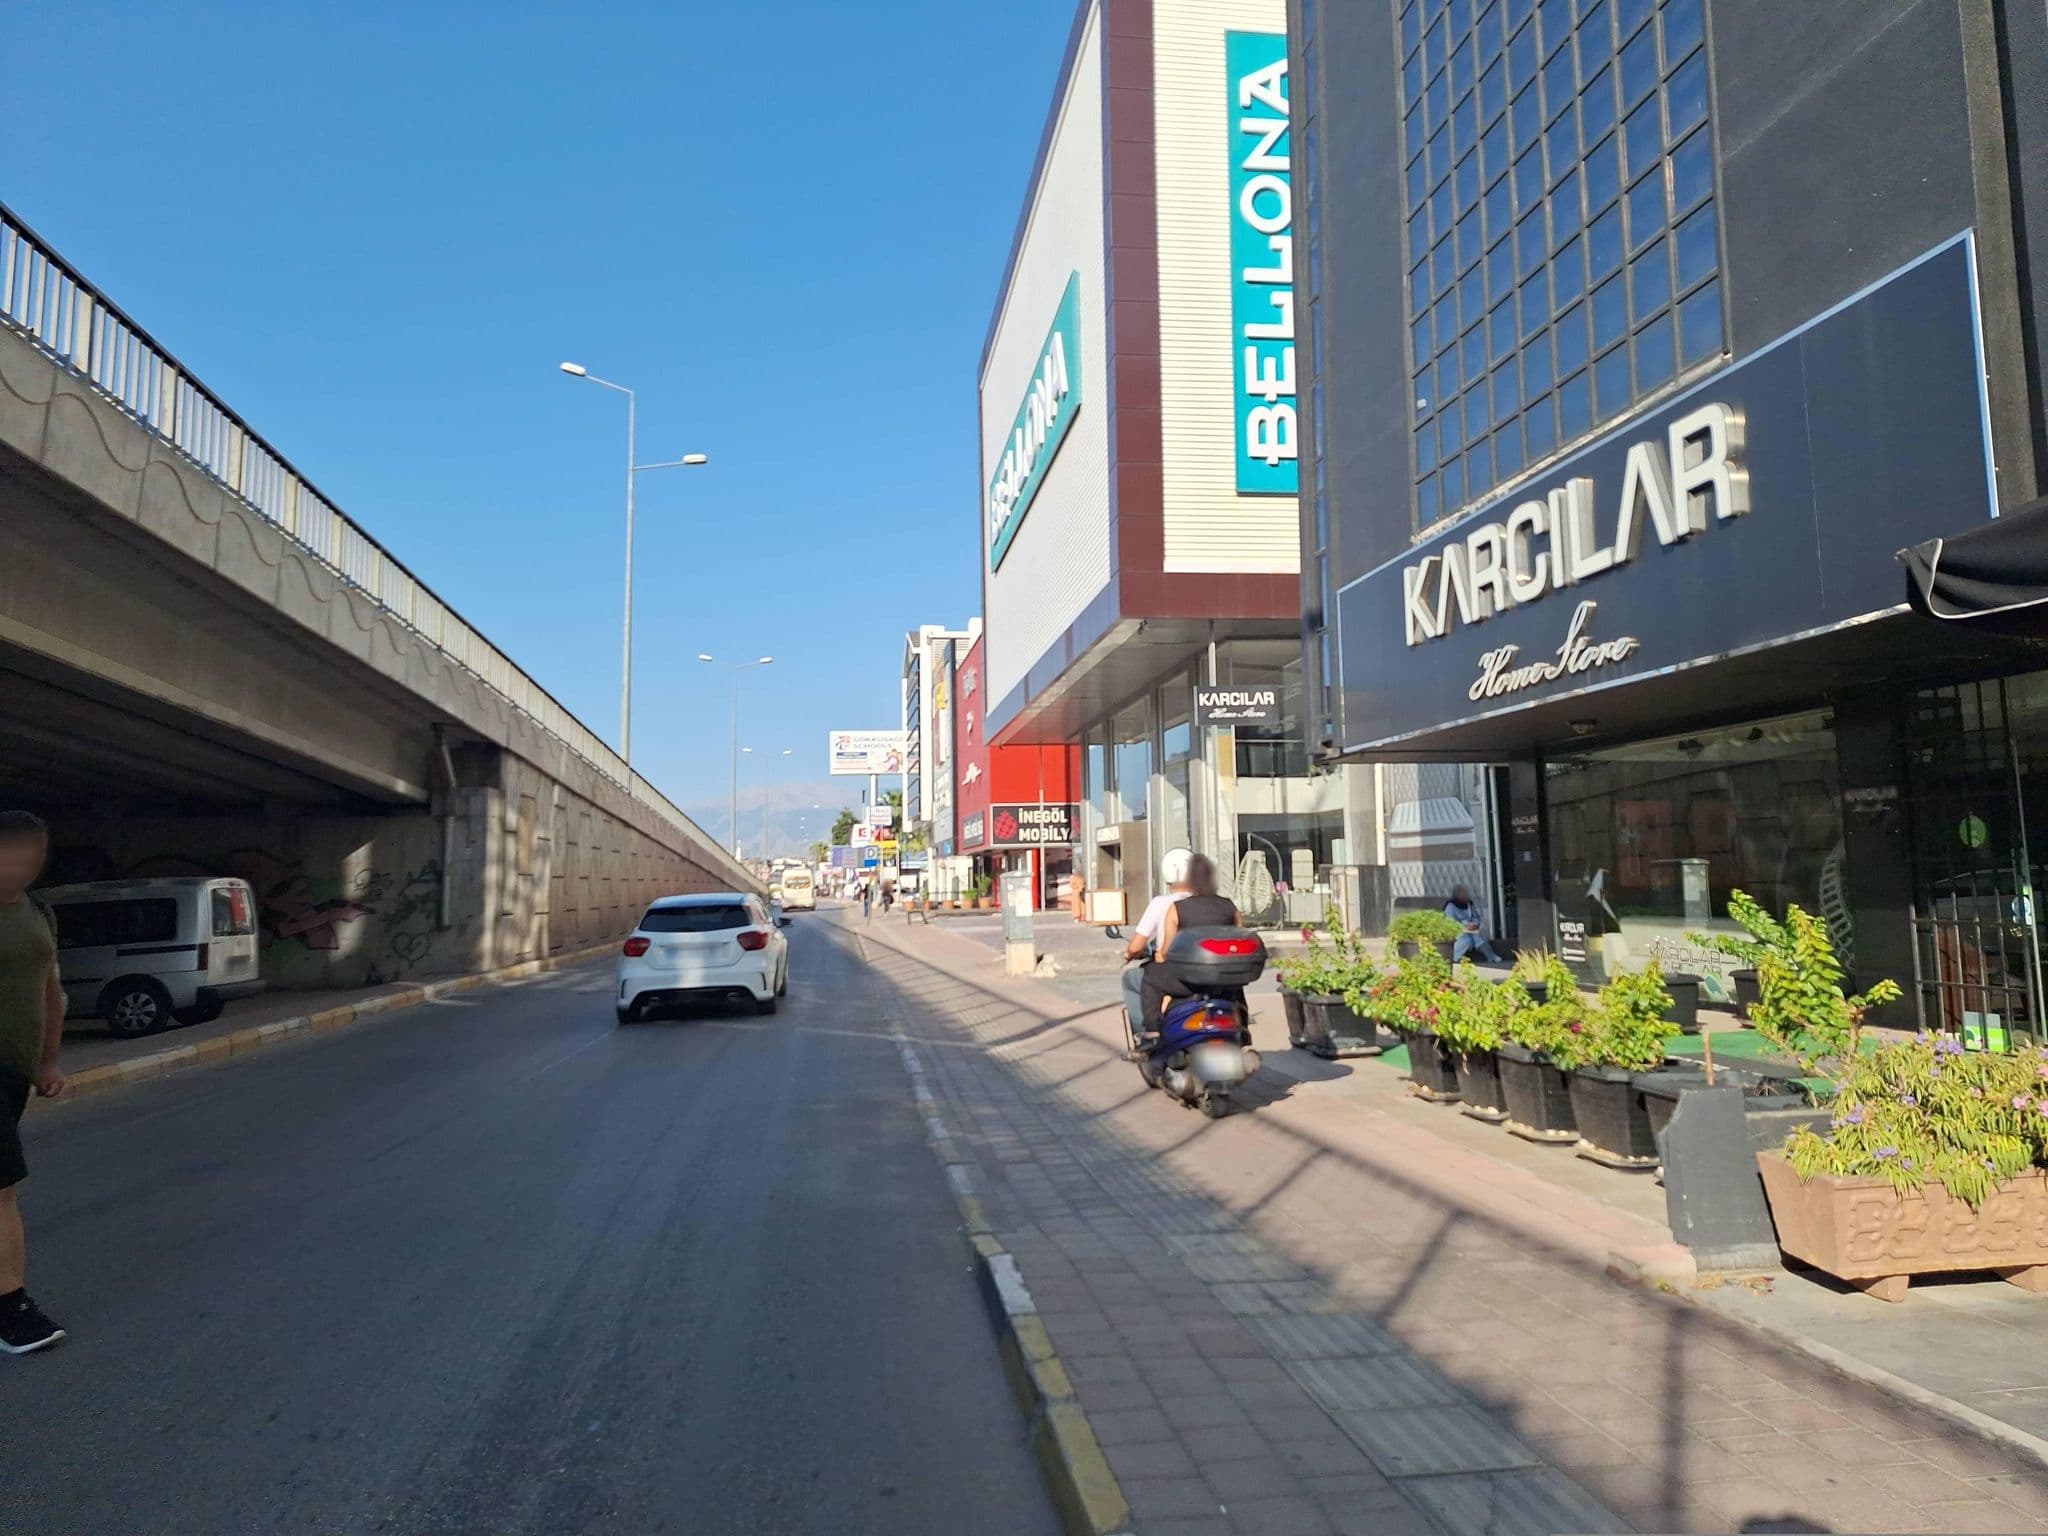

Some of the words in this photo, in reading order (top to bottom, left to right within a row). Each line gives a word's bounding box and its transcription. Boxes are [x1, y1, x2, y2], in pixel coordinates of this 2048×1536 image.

[1240, 58, 1298, 465] BELLONA
[1404, 402, 1750, 646] KARCILAR
[1198, 691, 1275, 706] KARCILAR
[1468, 644, 1552, 701] Home
[1548, 600, 1641, 680] Store
[1018, 807, 1068, 824] İNEGÖL
